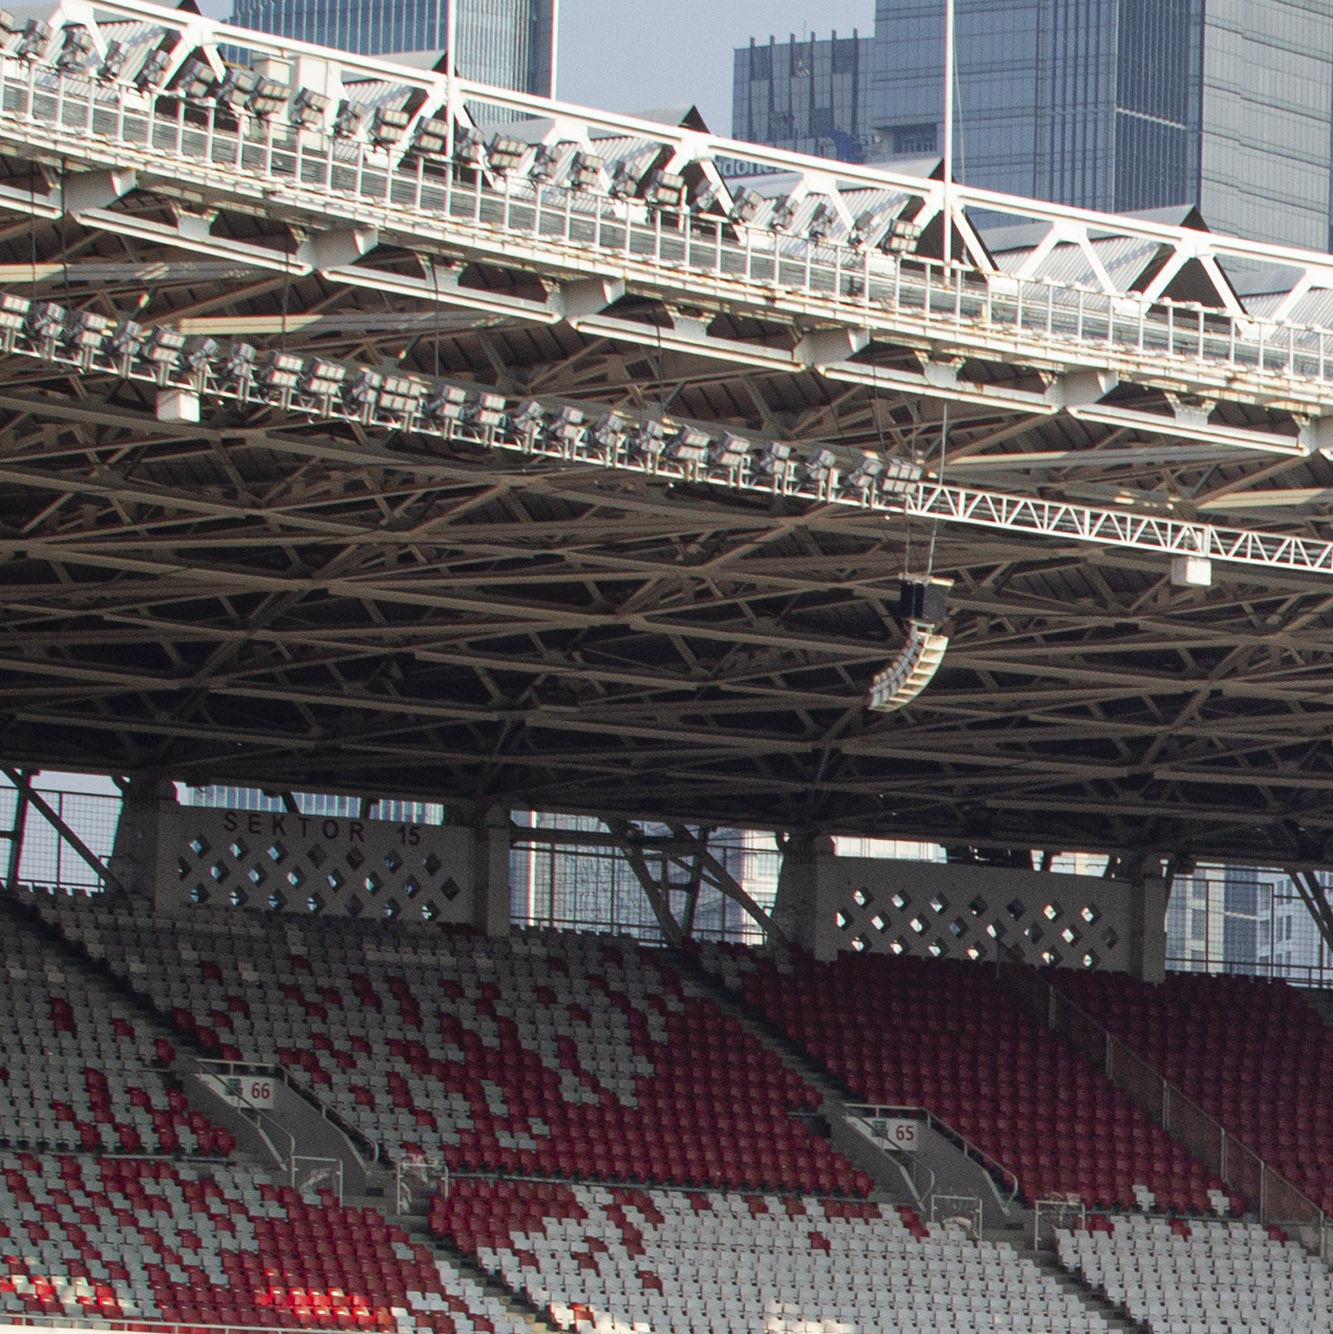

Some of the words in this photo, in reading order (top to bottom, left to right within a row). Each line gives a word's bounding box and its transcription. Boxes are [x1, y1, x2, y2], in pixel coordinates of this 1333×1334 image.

[224, 811, 364, 842] SEKTOR
[398, 826, 421, 846] 15
[252, 1082, 270, 1099] 66
[896, 1124, 914, 1141] 65
